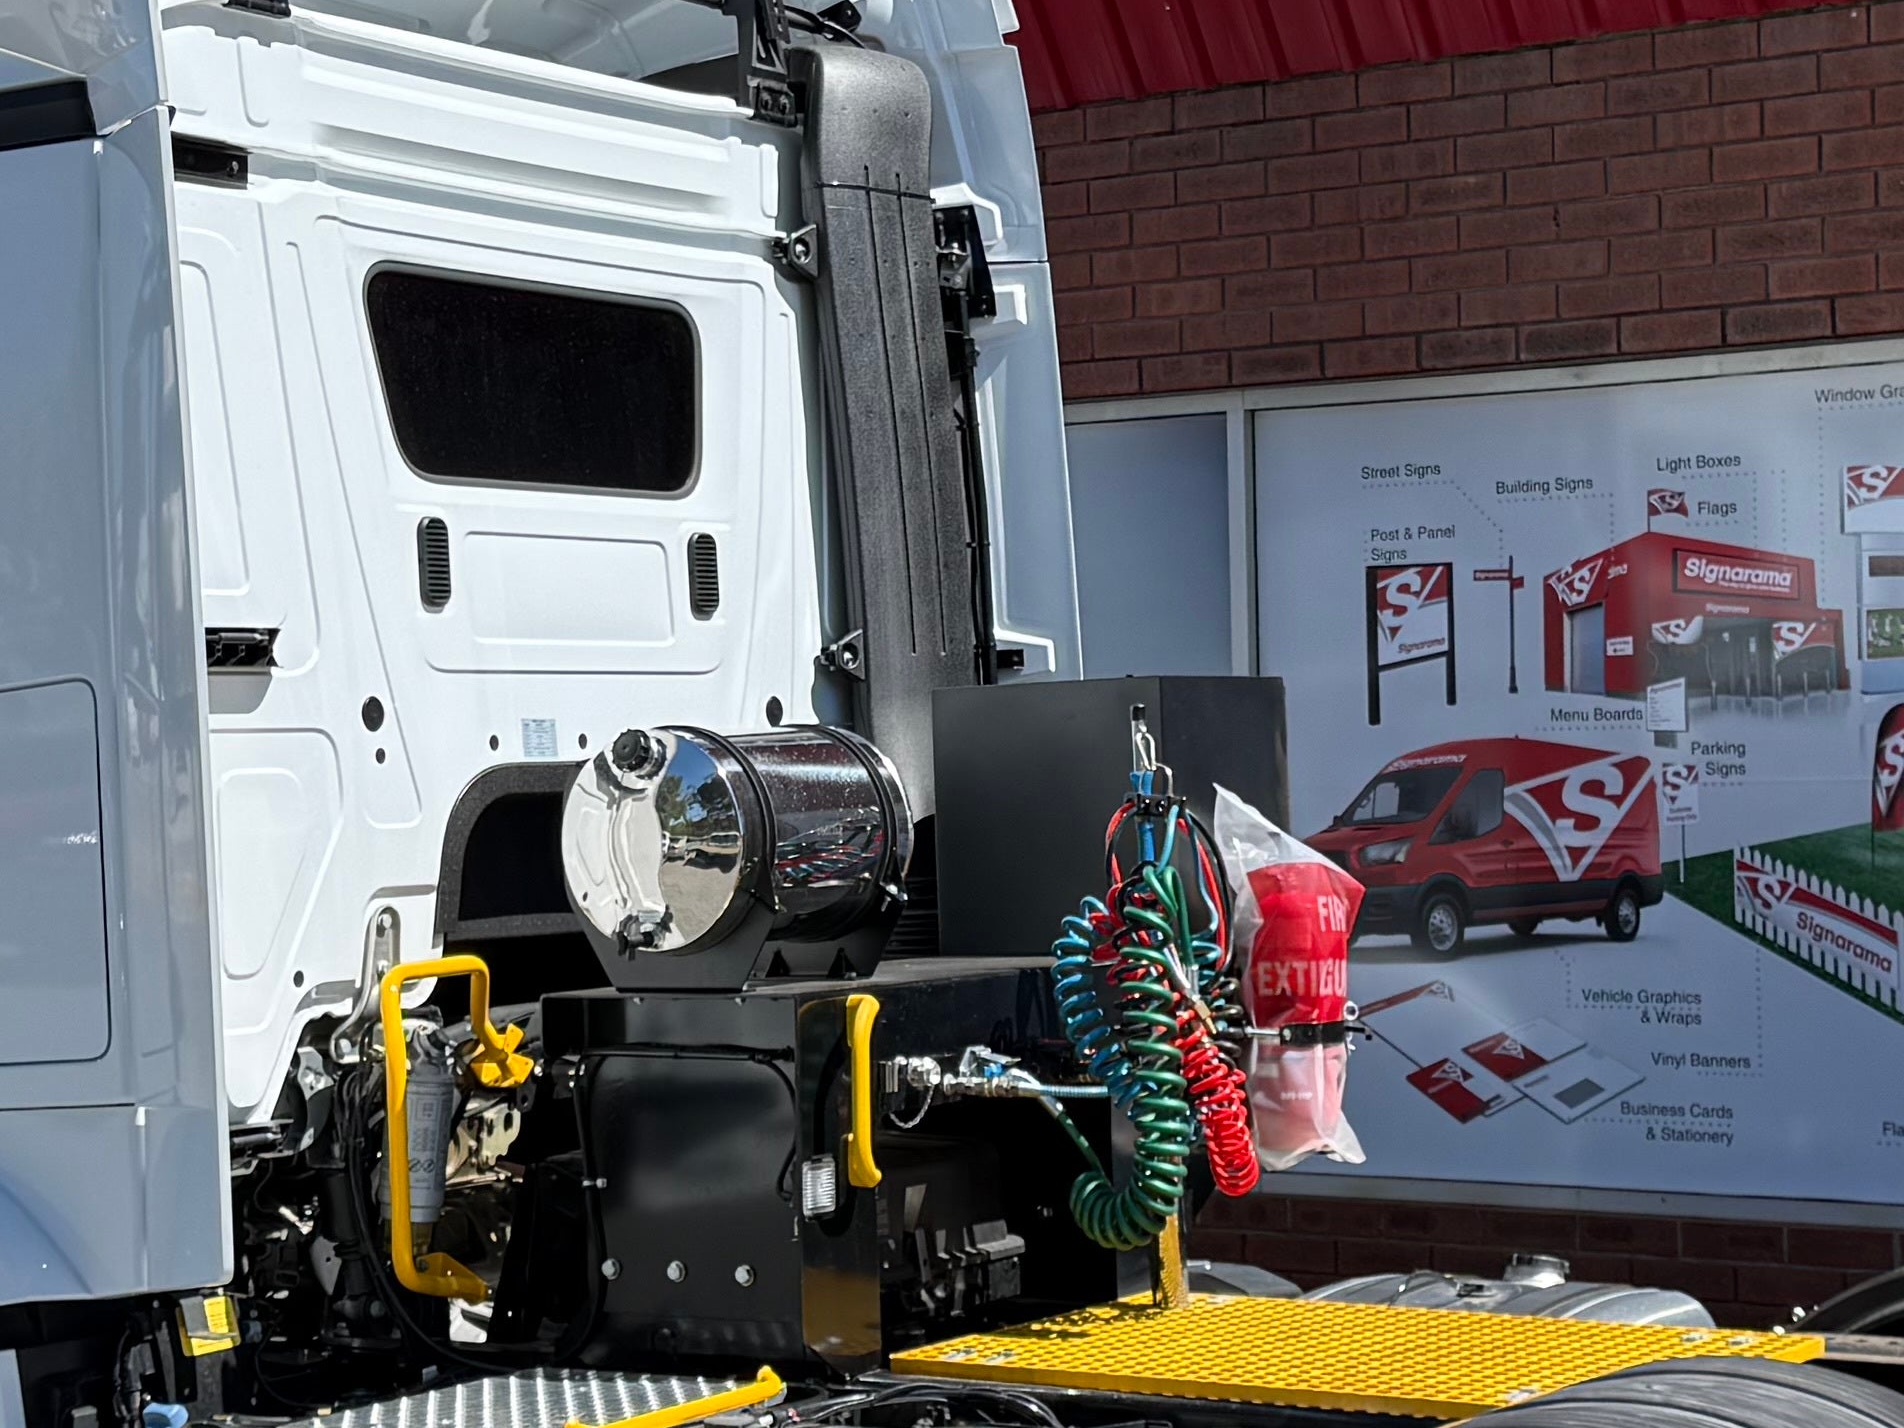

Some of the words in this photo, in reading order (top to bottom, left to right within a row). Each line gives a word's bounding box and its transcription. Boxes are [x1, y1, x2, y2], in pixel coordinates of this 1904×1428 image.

[1815, 388, 1876, 404] Window
[1361, 465, 1400, 480] Street
[1404, 463, 1441, 479] Signs
[1657, 457, 1692, 474] Light
[1696, 455, 1742, 470] Boxes
[1496, 479, 1550, 495] Building
[1555, 477, 1594, 493] Signs
[1698, 501, 1738, 517] Flags
[1371, 529, 1400, 542] Post
[1404, 527, 1413, 541] &
[1418, 525, 1456, 540] Panel
[1371, 548, 1408, 564] Signs
[1684, 558, 1792, 587] Signarama
[1550, 708, 1589, 722] Menu
[1594, 707, 1644, 721] Boards
[1691, 741, 1746, 757] Parking
[1705, 762, 1746, 778] Signs
[1317, 895, 1346, 932] FIR
[1797, 911, 1893, 972] Signarama
[1582, 989, 1633, 1004] Vehicle
[1637, 990, 1702, 1009] Graphics
[1641, 1011, 1651, 1024] &
[1656, 1011, 1702, 1028] Wraps
[1651, 1052, 1686, 1070] Vinyl
[1690, 1054, 1751, 1069] Banners
[1620, 1102, 1686, 1117] Business
[1690, 1104, 1734, 1120] Cards
[1646, 1128, 1656, 1141] &
[1661, 1128, 1734, 1147] Stationery
